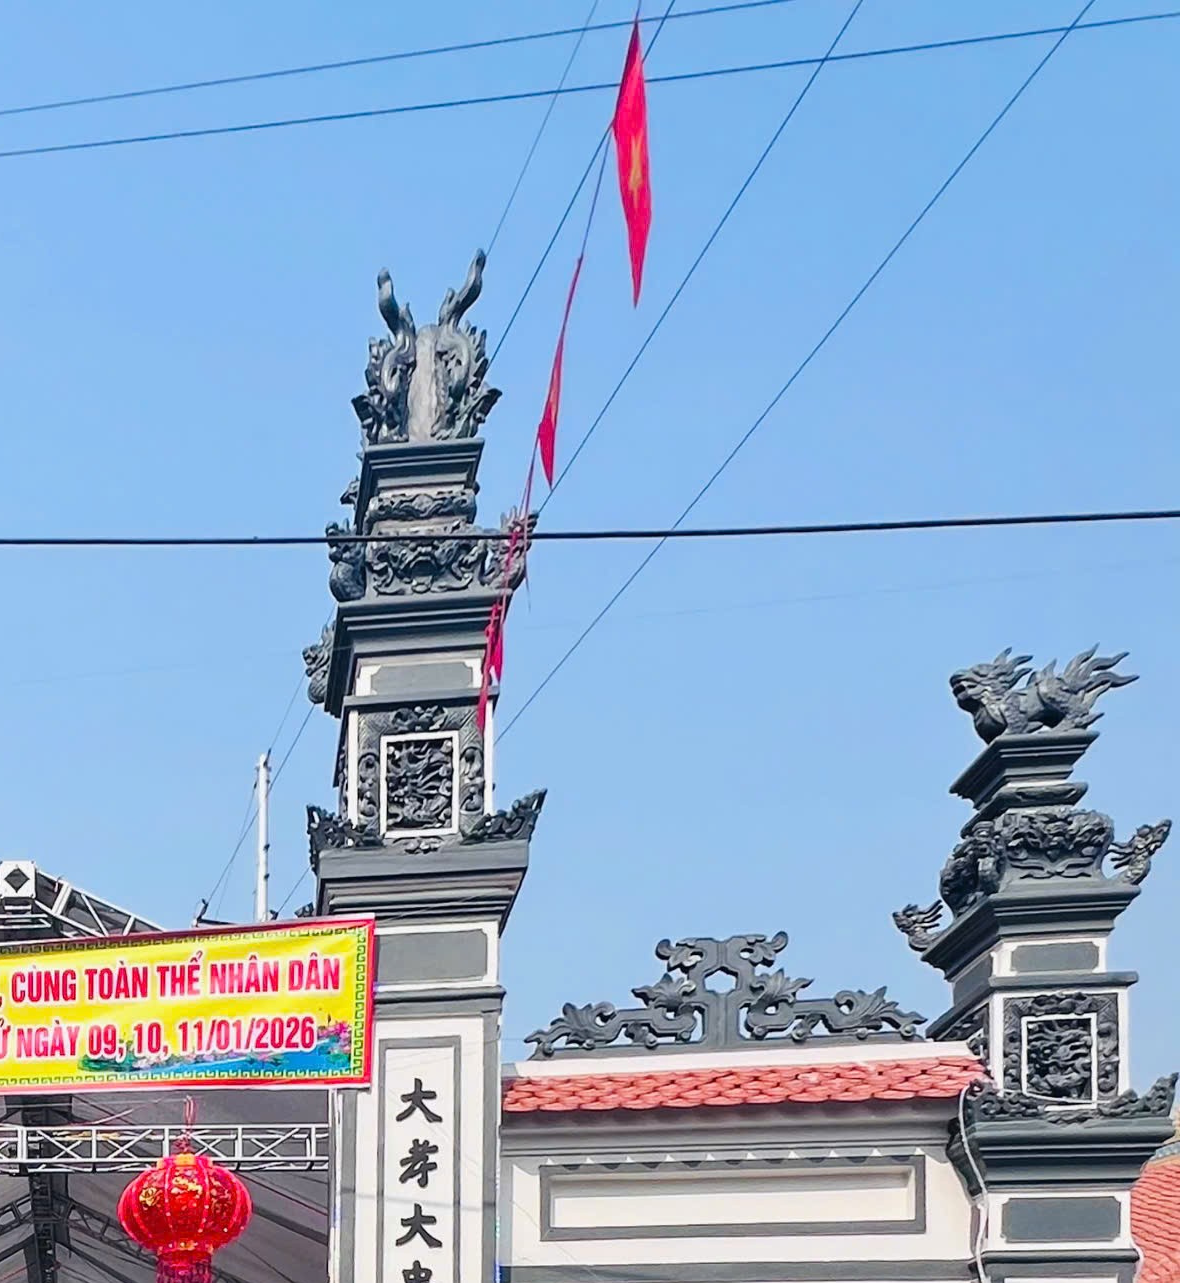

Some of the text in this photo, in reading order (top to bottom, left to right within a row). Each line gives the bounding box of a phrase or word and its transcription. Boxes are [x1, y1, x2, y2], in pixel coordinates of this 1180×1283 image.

[85, 961, 149, 1000] TOÀN
[156, 950, 203, 997] THỂ
[209, 954, 280, 995] NHÂN
[288, 951, 341, 992] DÂN
[16, 1019, 80, 1058] NGÀY
[133, 1021, 169, 1056] 10,
[178, 1016, 316, 1052] 11/01/2026
